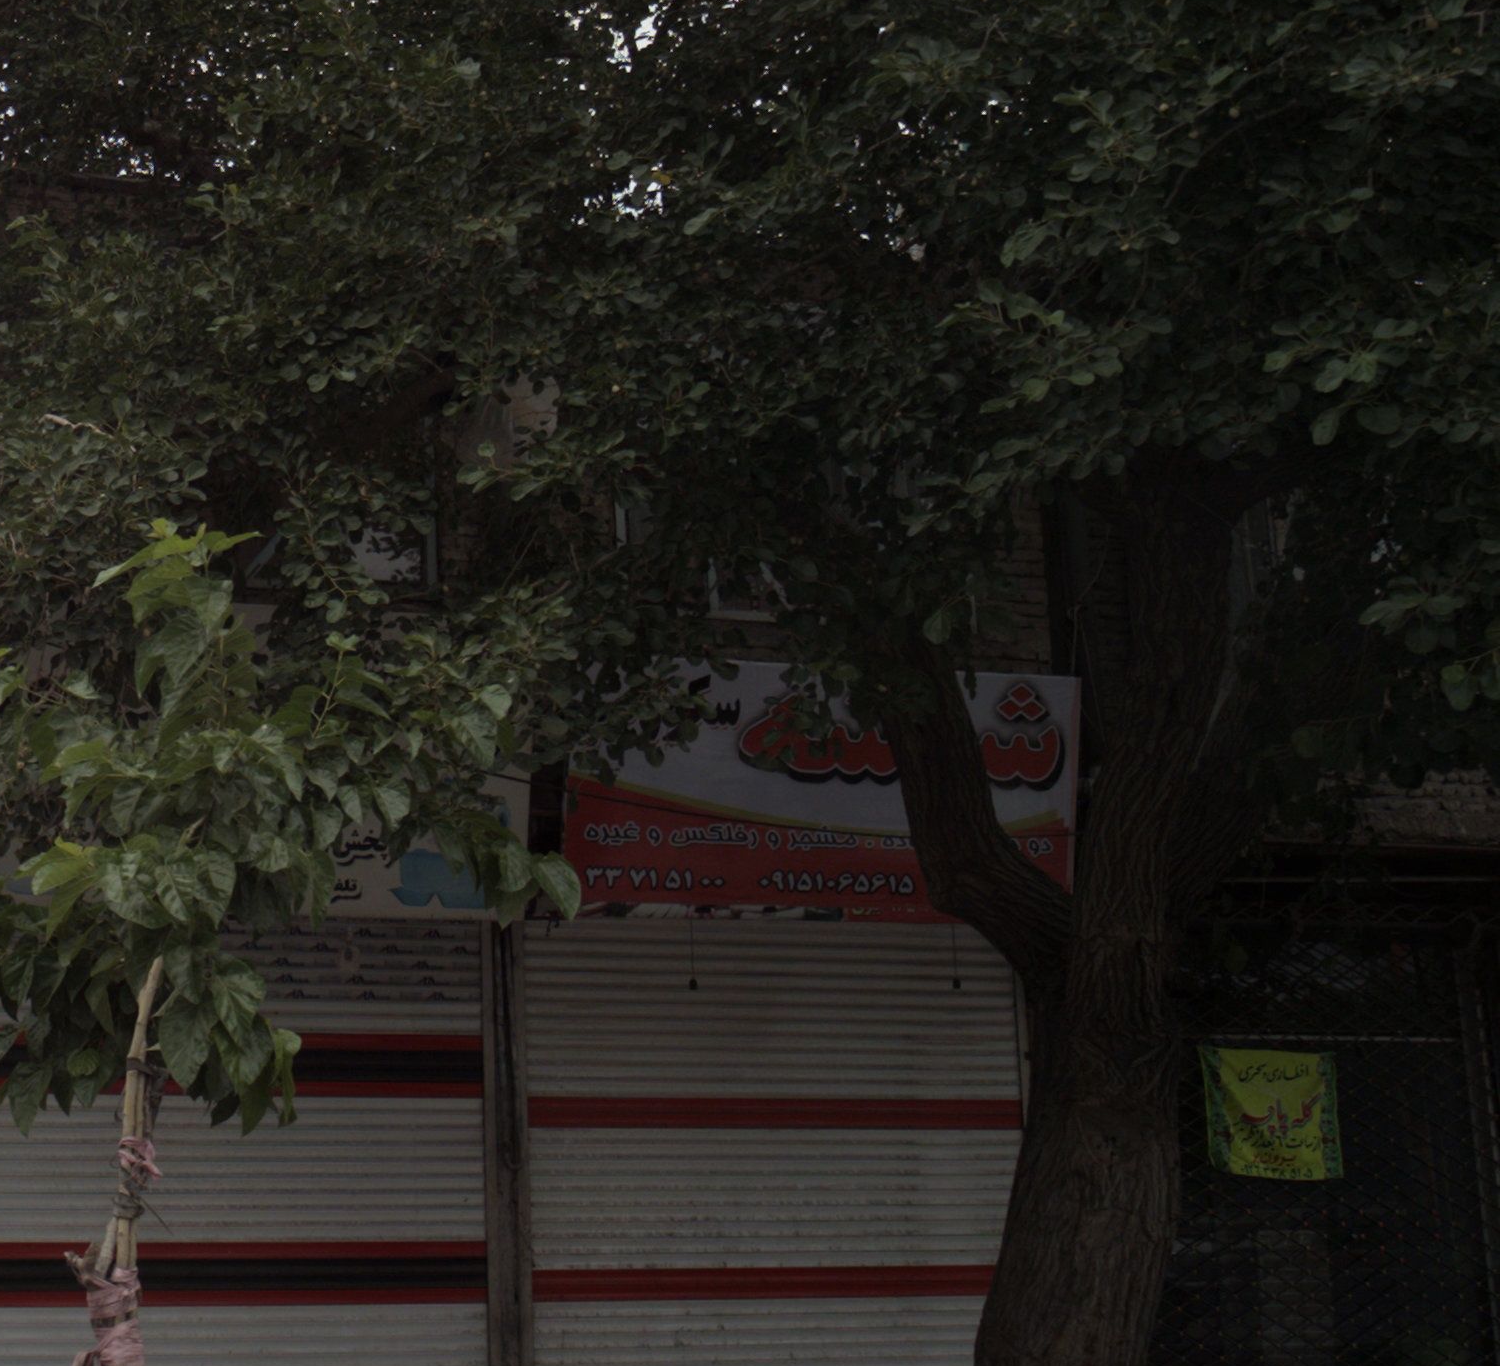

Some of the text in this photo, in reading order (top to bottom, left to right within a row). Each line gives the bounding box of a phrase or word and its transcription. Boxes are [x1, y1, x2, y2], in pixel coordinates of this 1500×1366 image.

[584, 820, 641, 846] غیره
[648, 826, 663, 846] و
[669, 823, 759, 848] رفلکس
[766, 831, 783, 850] و
[759, 869, 915, 894] ۰۹۱۵۱۰۶۵۶۱۵
[1240, 1092, 1321, 1136] کله پاچه
